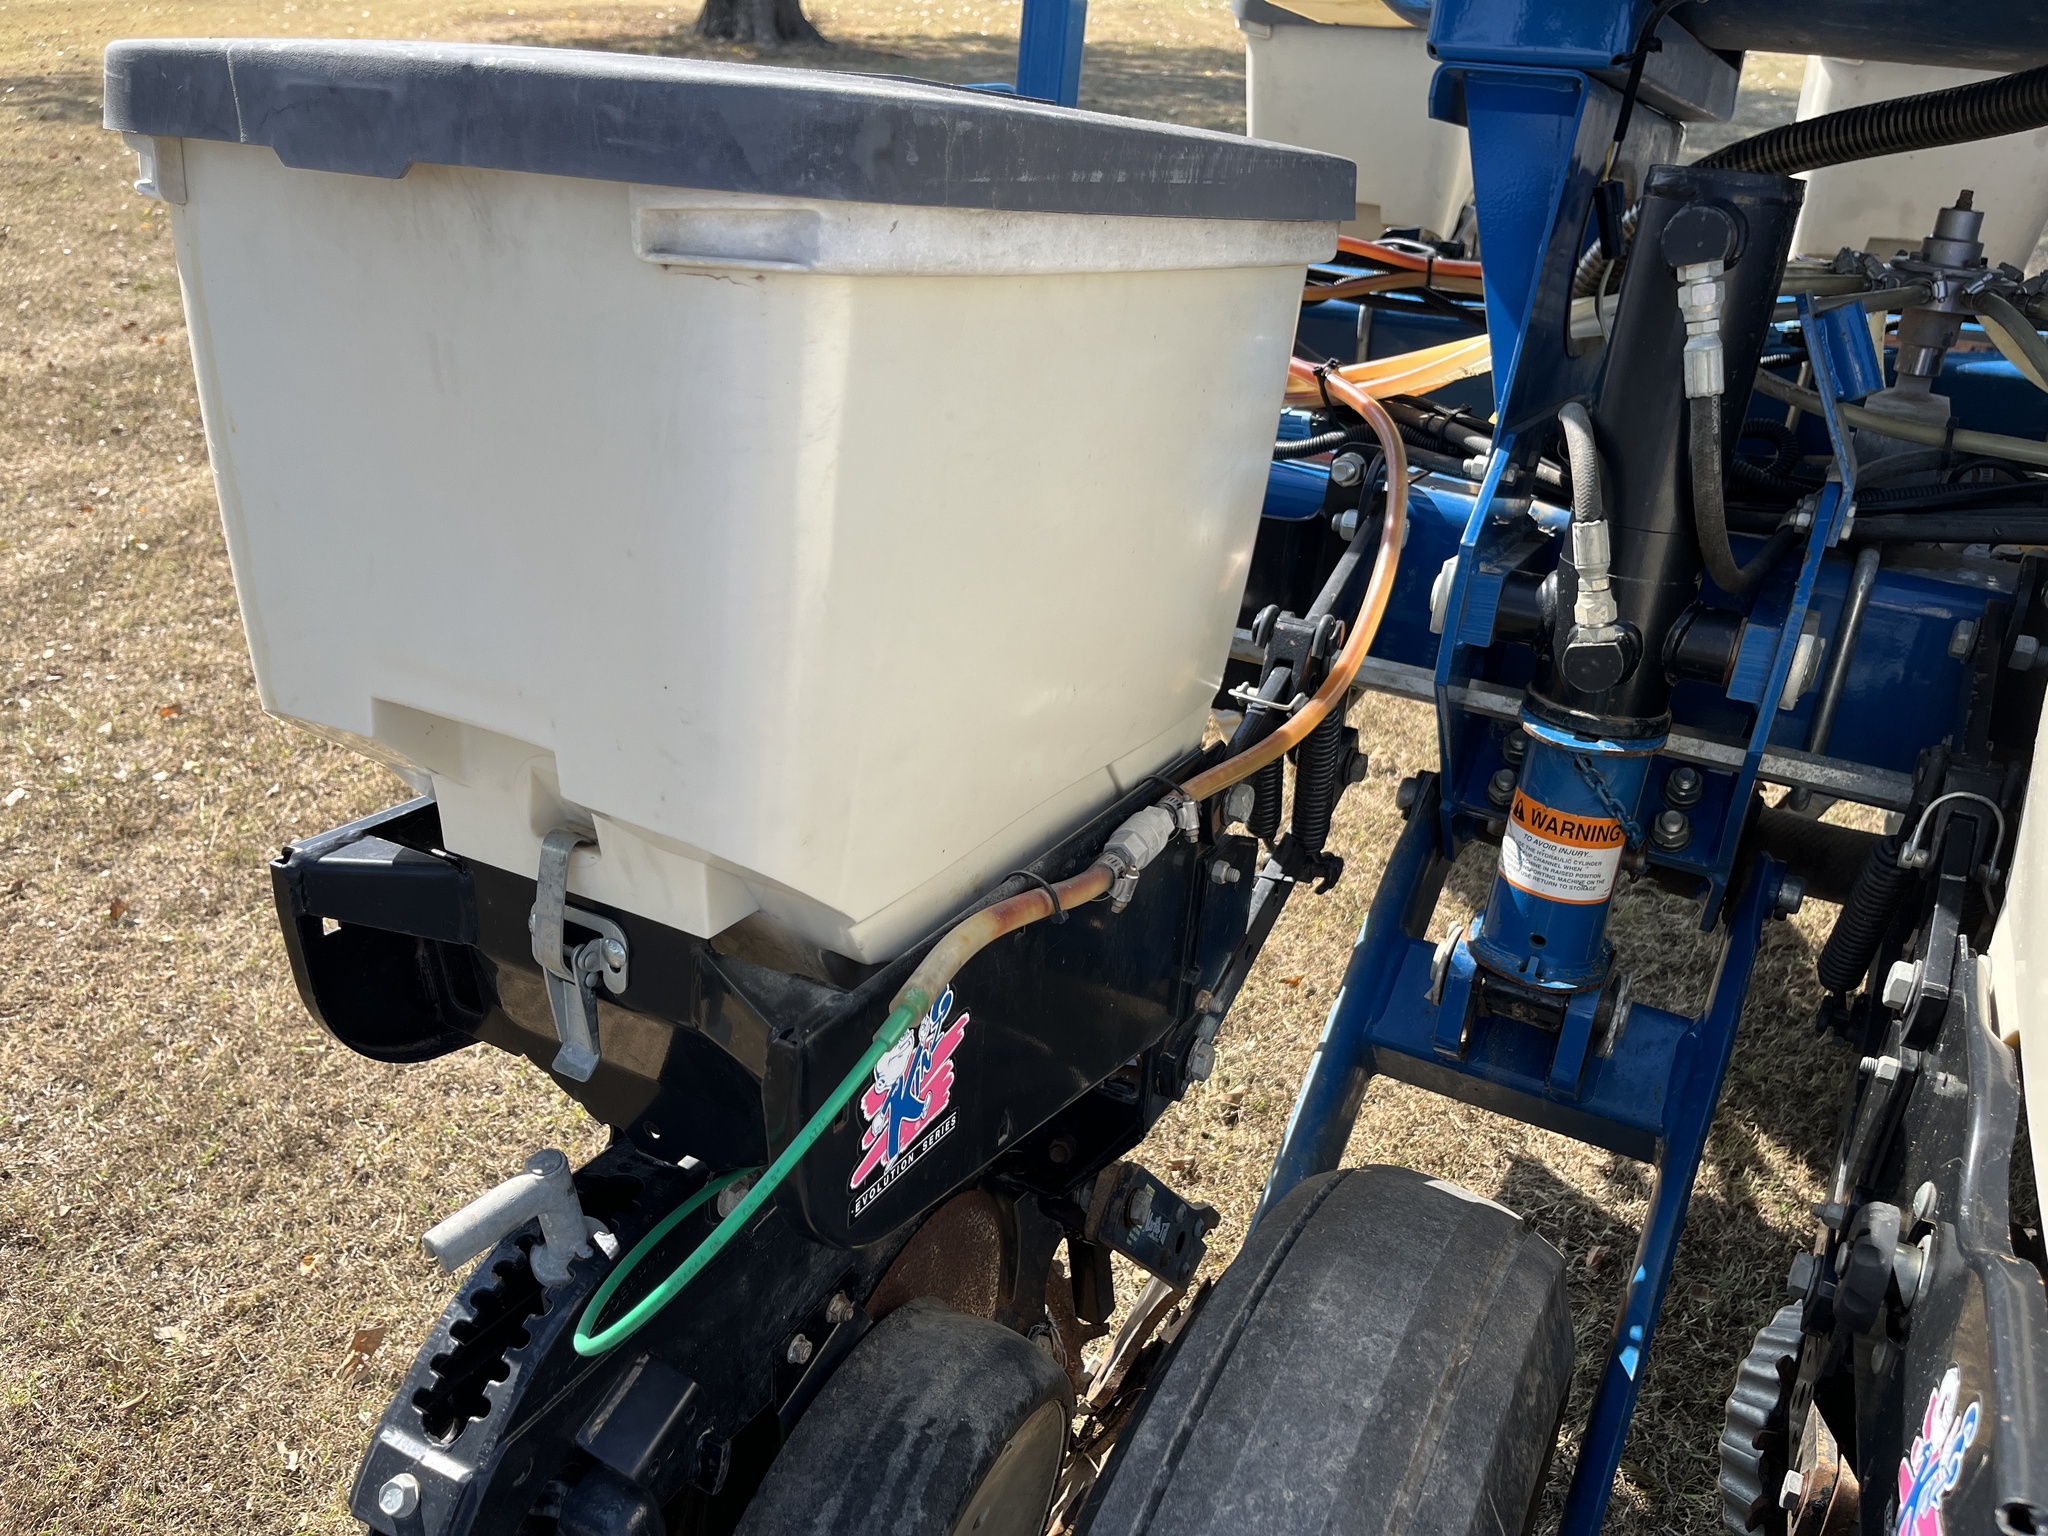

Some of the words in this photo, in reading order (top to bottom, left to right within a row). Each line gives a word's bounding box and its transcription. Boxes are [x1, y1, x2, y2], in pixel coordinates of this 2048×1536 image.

[1531, 808, 1621, 842] WARNING
[1523, 833, 1533, 842] TO
[1533, 839, 1557, 851] AVOID
[1525, 845, 1536, 853] THE
[1537, 850, 1572, 864] HYDRAULIC
[1533, 855, 1561, 869] CHANNEL
[1563, 864, 1582, 872] WHEN
[1550, 867, 1574, 878] RAISED
[1556, 876, 1585, 885] MACHINE
[1532, 875, 1557, 888] RETURN
[854, 1152, 914, 1212] EVOLUTION
[922, 1114, 957, 1151] SERIES
